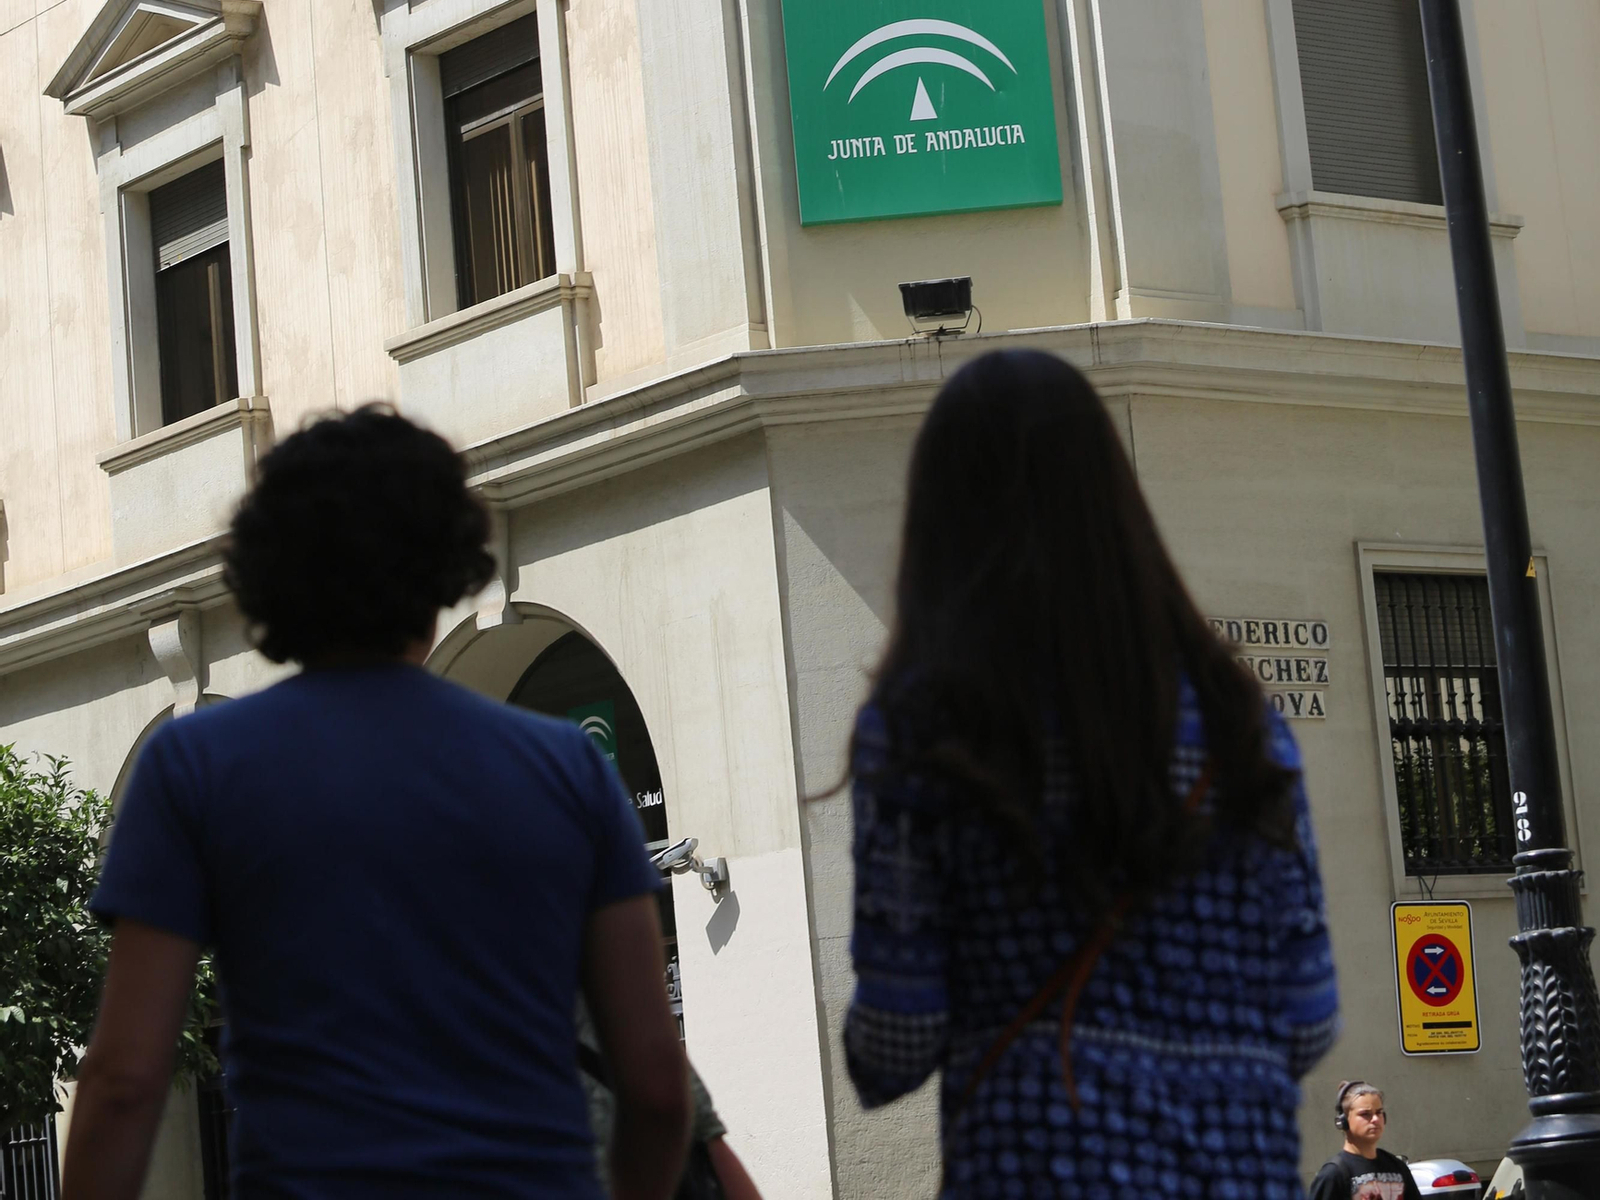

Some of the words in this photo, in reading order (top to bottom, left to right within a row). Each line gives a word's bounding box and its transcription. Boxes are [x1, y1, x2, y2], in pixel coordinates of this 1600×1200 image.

[827, 136, 886, 160] JUNTA
[894, 133, 918, 154] DE
[925, 124, 1025, 151] ANDALUCIA
[637, 788, 663, 809] Salud
